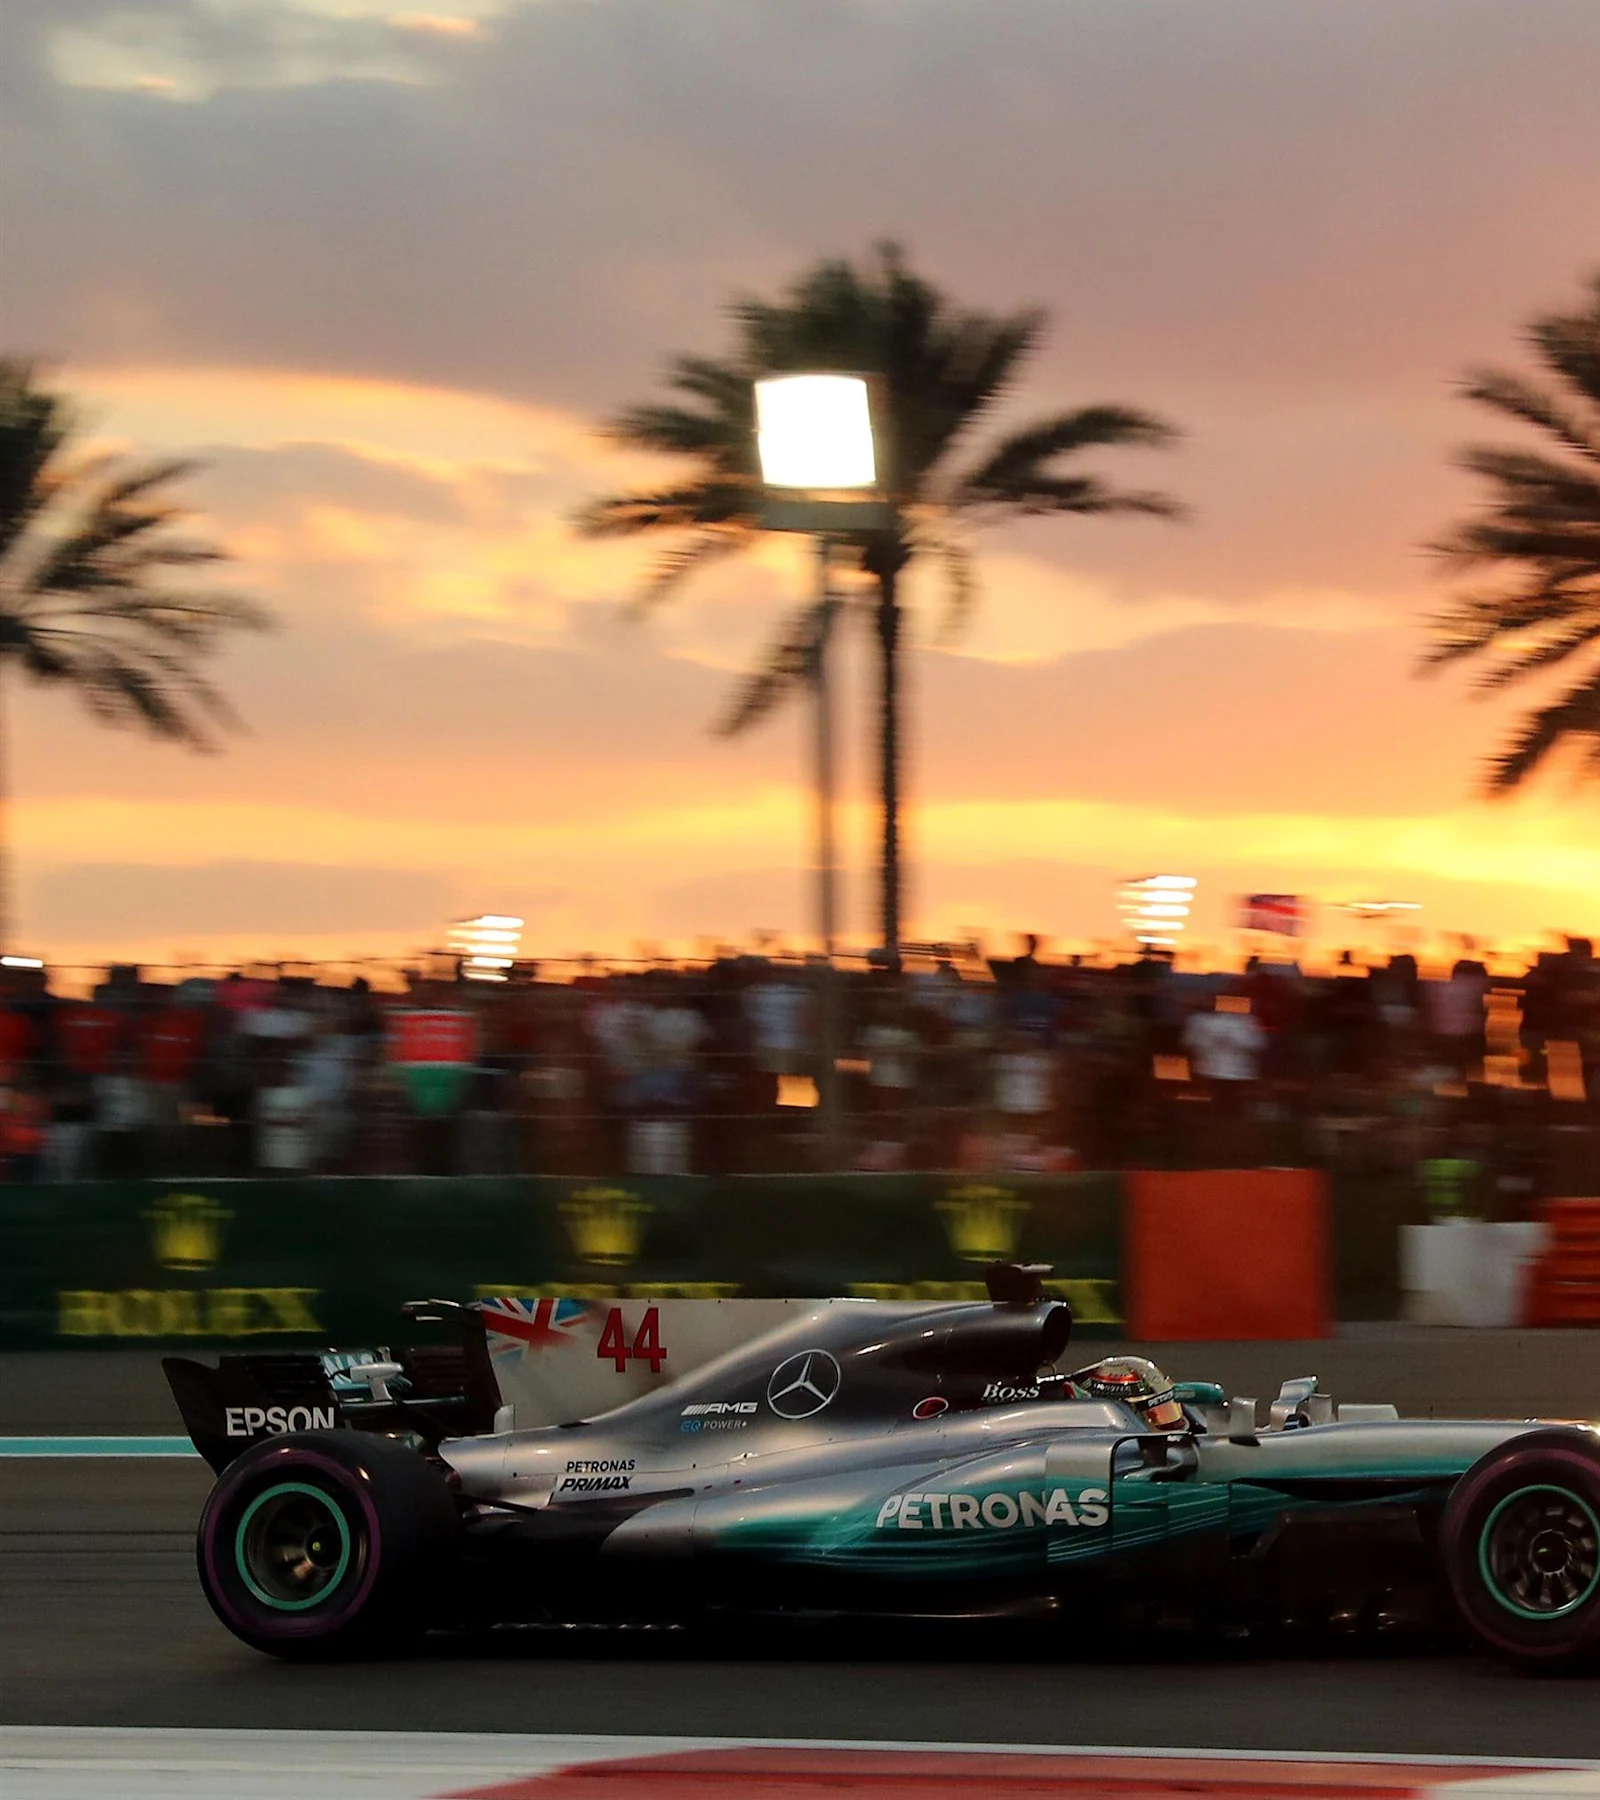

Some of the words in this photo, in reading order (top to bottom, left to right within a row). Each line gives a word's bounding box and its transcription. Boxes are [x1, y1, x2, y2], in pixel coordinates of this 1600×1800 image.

[597, 1307, 668, 1374] 44
[982, 1383, 1040, 1399] BOSS
[704, 1402, 758, 1414] AMG
[225, 1406, 335, 1436] EPSON
[566, 1459, 635, 1473] PETRONAS
[560, 1475, 633, 1492] PRIMAX
[876, 1488, 1109, 1529] PETRONAS
